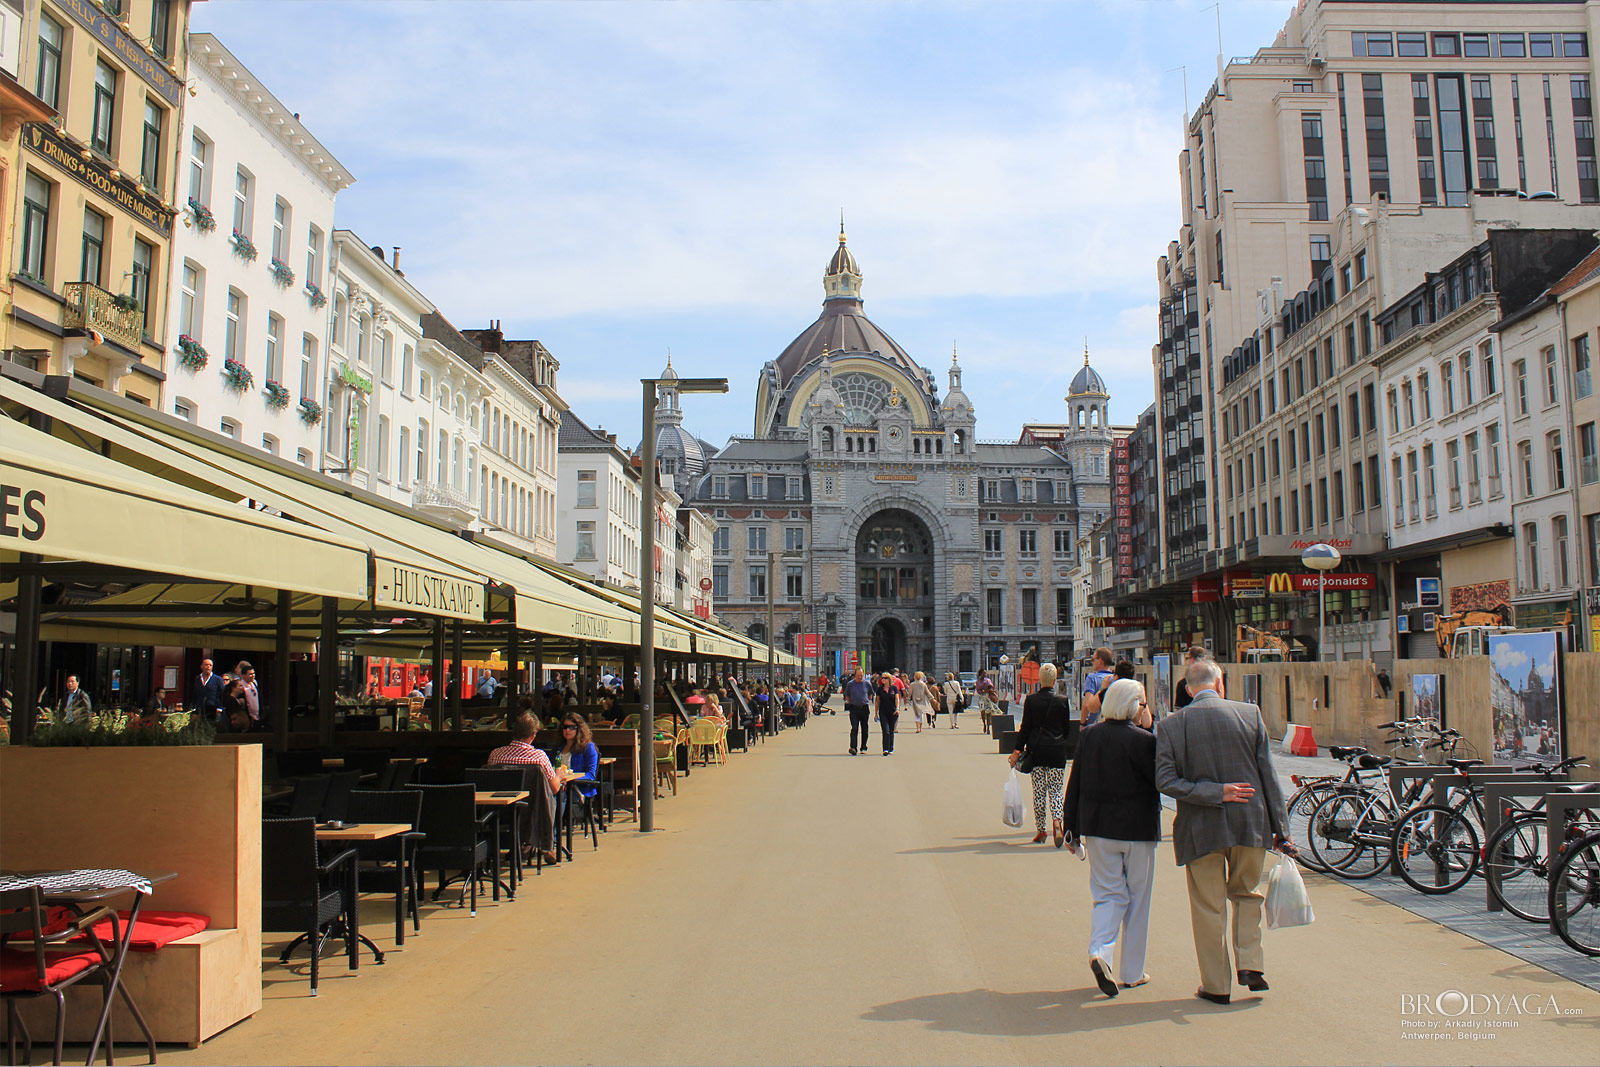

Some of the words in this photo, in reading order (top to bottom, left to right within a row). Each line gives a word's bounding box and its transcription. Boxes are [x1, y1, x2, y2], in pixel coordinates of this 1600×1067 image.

[115, 37, 144, 70] IRISH
[145, 62, 165, 88] PUB
[44, 139, 78, 172] DRINKS
[86, 167, 111, 193] FOOD
[117, 188, 133, 208] LIVE
[133, 199, 157, 224] MUSIC
[1116, 440, 1126, 458] DE
[0, 484, 46, 541] ES
[1117, 465, 1128, 527] KEYSER
[393, 566, 474, 614] HULSTKAMP
[1302, 577, 1368, 586] McDonald's
